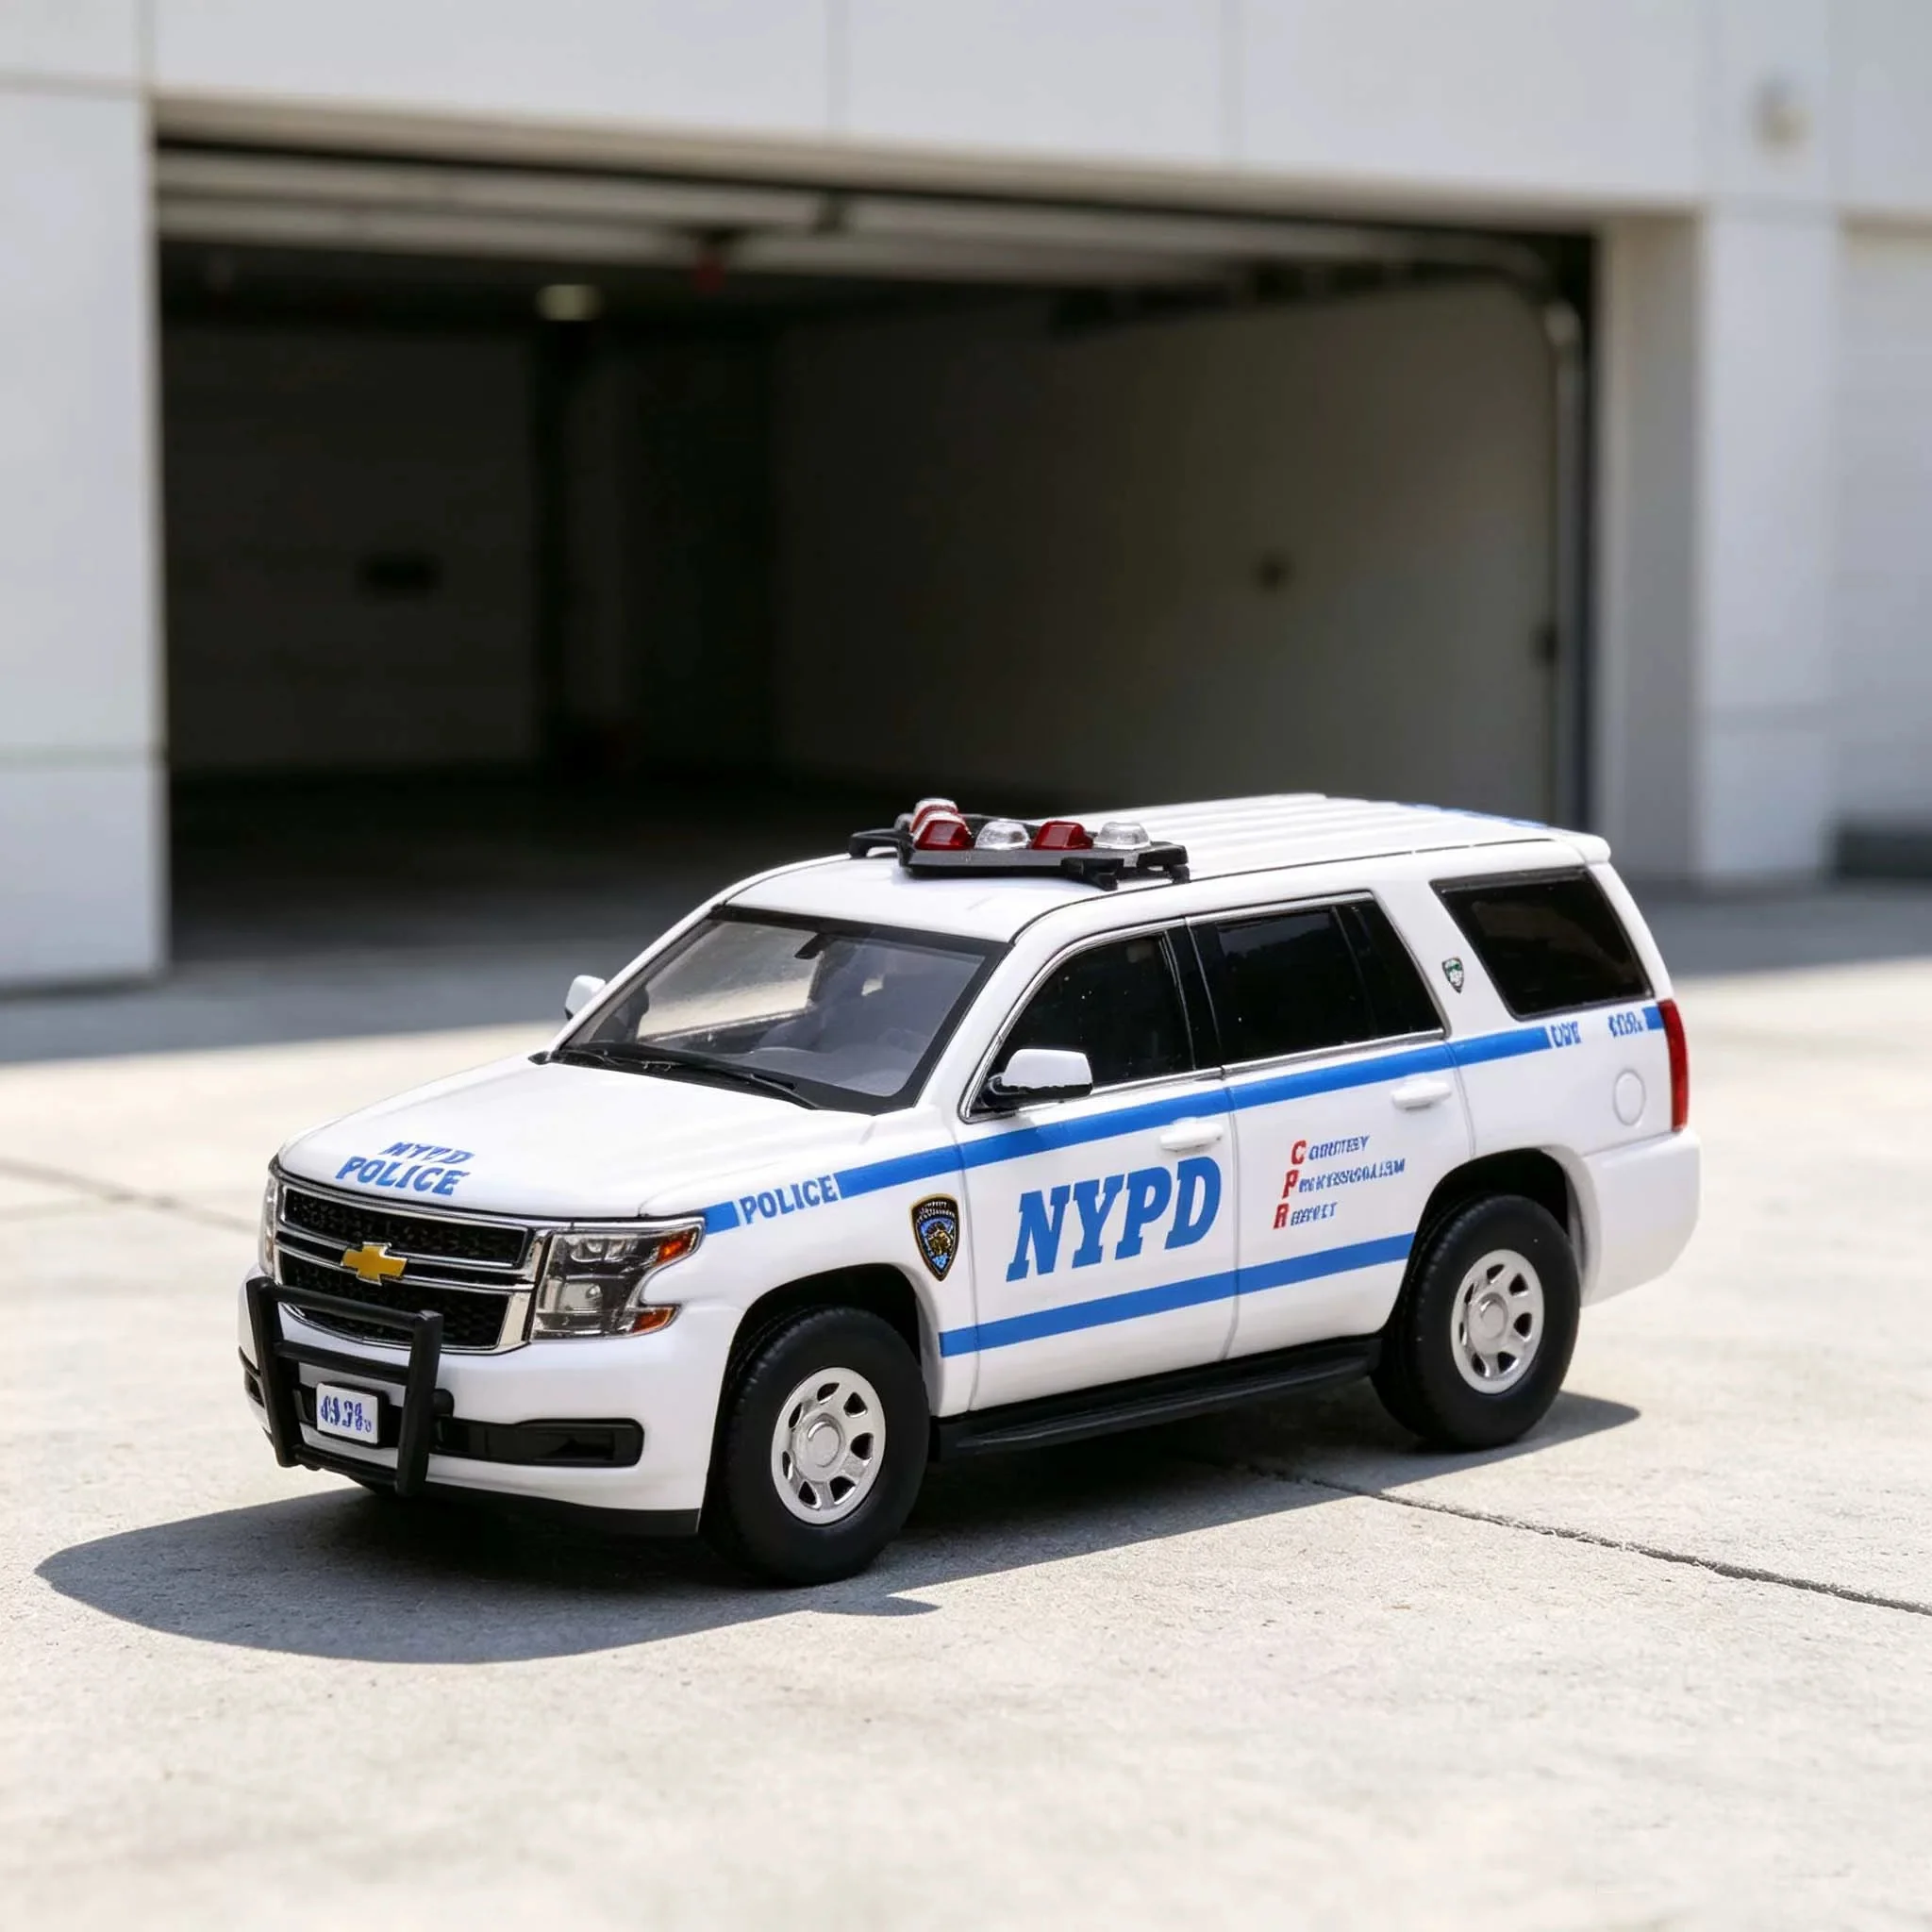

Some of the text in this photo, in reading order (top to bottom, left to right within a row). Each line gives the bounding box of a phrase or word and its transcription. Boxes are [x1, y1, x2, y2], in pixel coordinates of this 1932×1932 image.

[335, 1156, 471, 1196] POLICE
[740, 1174, 839, 1224] POLICE
[1006, 1156, 1222, 1283] NYPD
